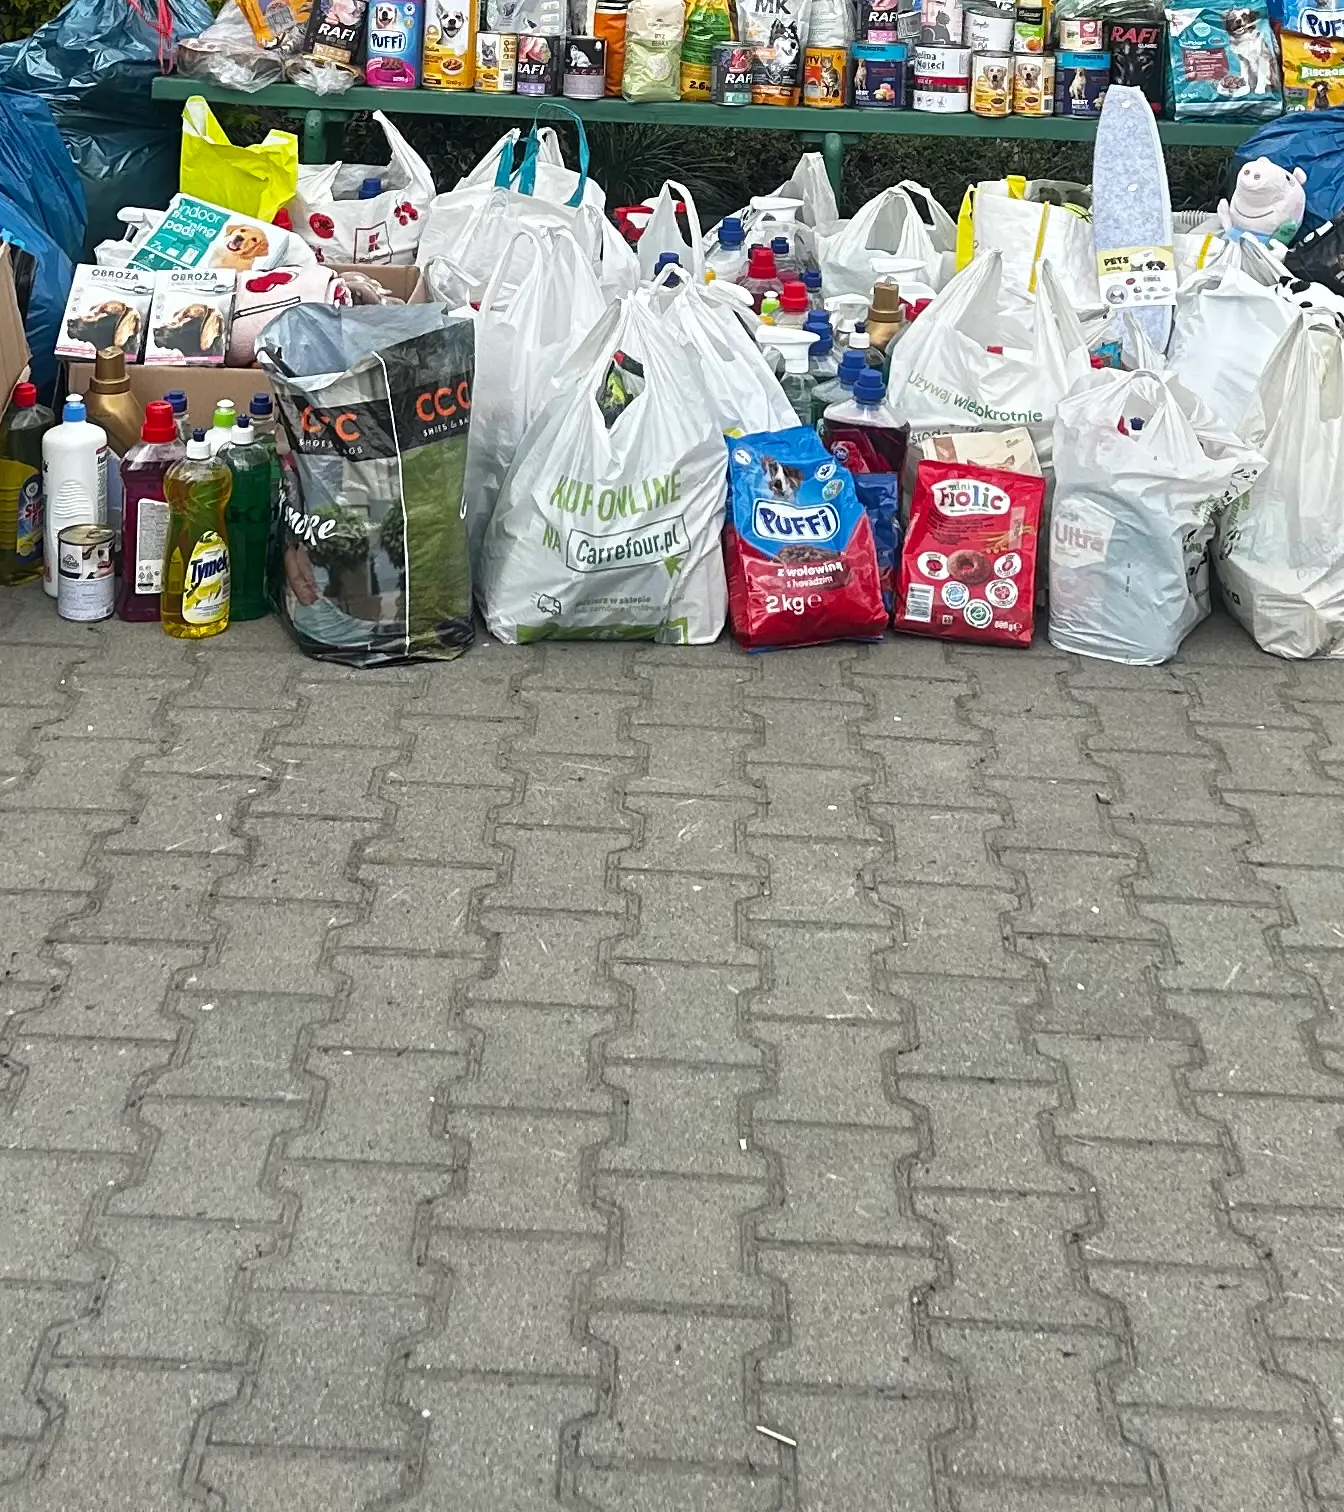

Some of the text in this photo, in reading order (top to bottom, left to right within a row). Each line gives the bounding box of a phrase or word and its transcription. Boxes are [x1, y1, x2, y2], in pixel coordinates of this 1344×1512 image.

[868, 12, 898, 23] RAF
[318, 23, 355, 42] RAFI
[1110, 26, 1161, 44] RAFI
[517, 63, 545, 76] RAFI
[725, 73, 753, 84] RAF
[178, 199, 221, 224] indoor
[163, 220, 195, 238] pads
[1104, 256, 1129, 266] PETS
[91, 269, 139, 281] OBROŻA
[172, 272, 218, 281] OBROŻA
[416, 380, 471, 422] CCC
[300, 405, 360, 441] CC
[423, 424, 448, 437] SHOES
[299, 438, 333, 449] SHOES
[597, 470, 681, 521] ONLINE
[542, 523, 681, 565] NA Carrefour.pl
[1055, 521, 1104, 551] Ultra
[190, 549, 228, 588] Tymek
[777, 569, 784, 577] z
[765, 595, 780, 614] 2
[782, 594, 805, 615] kg
